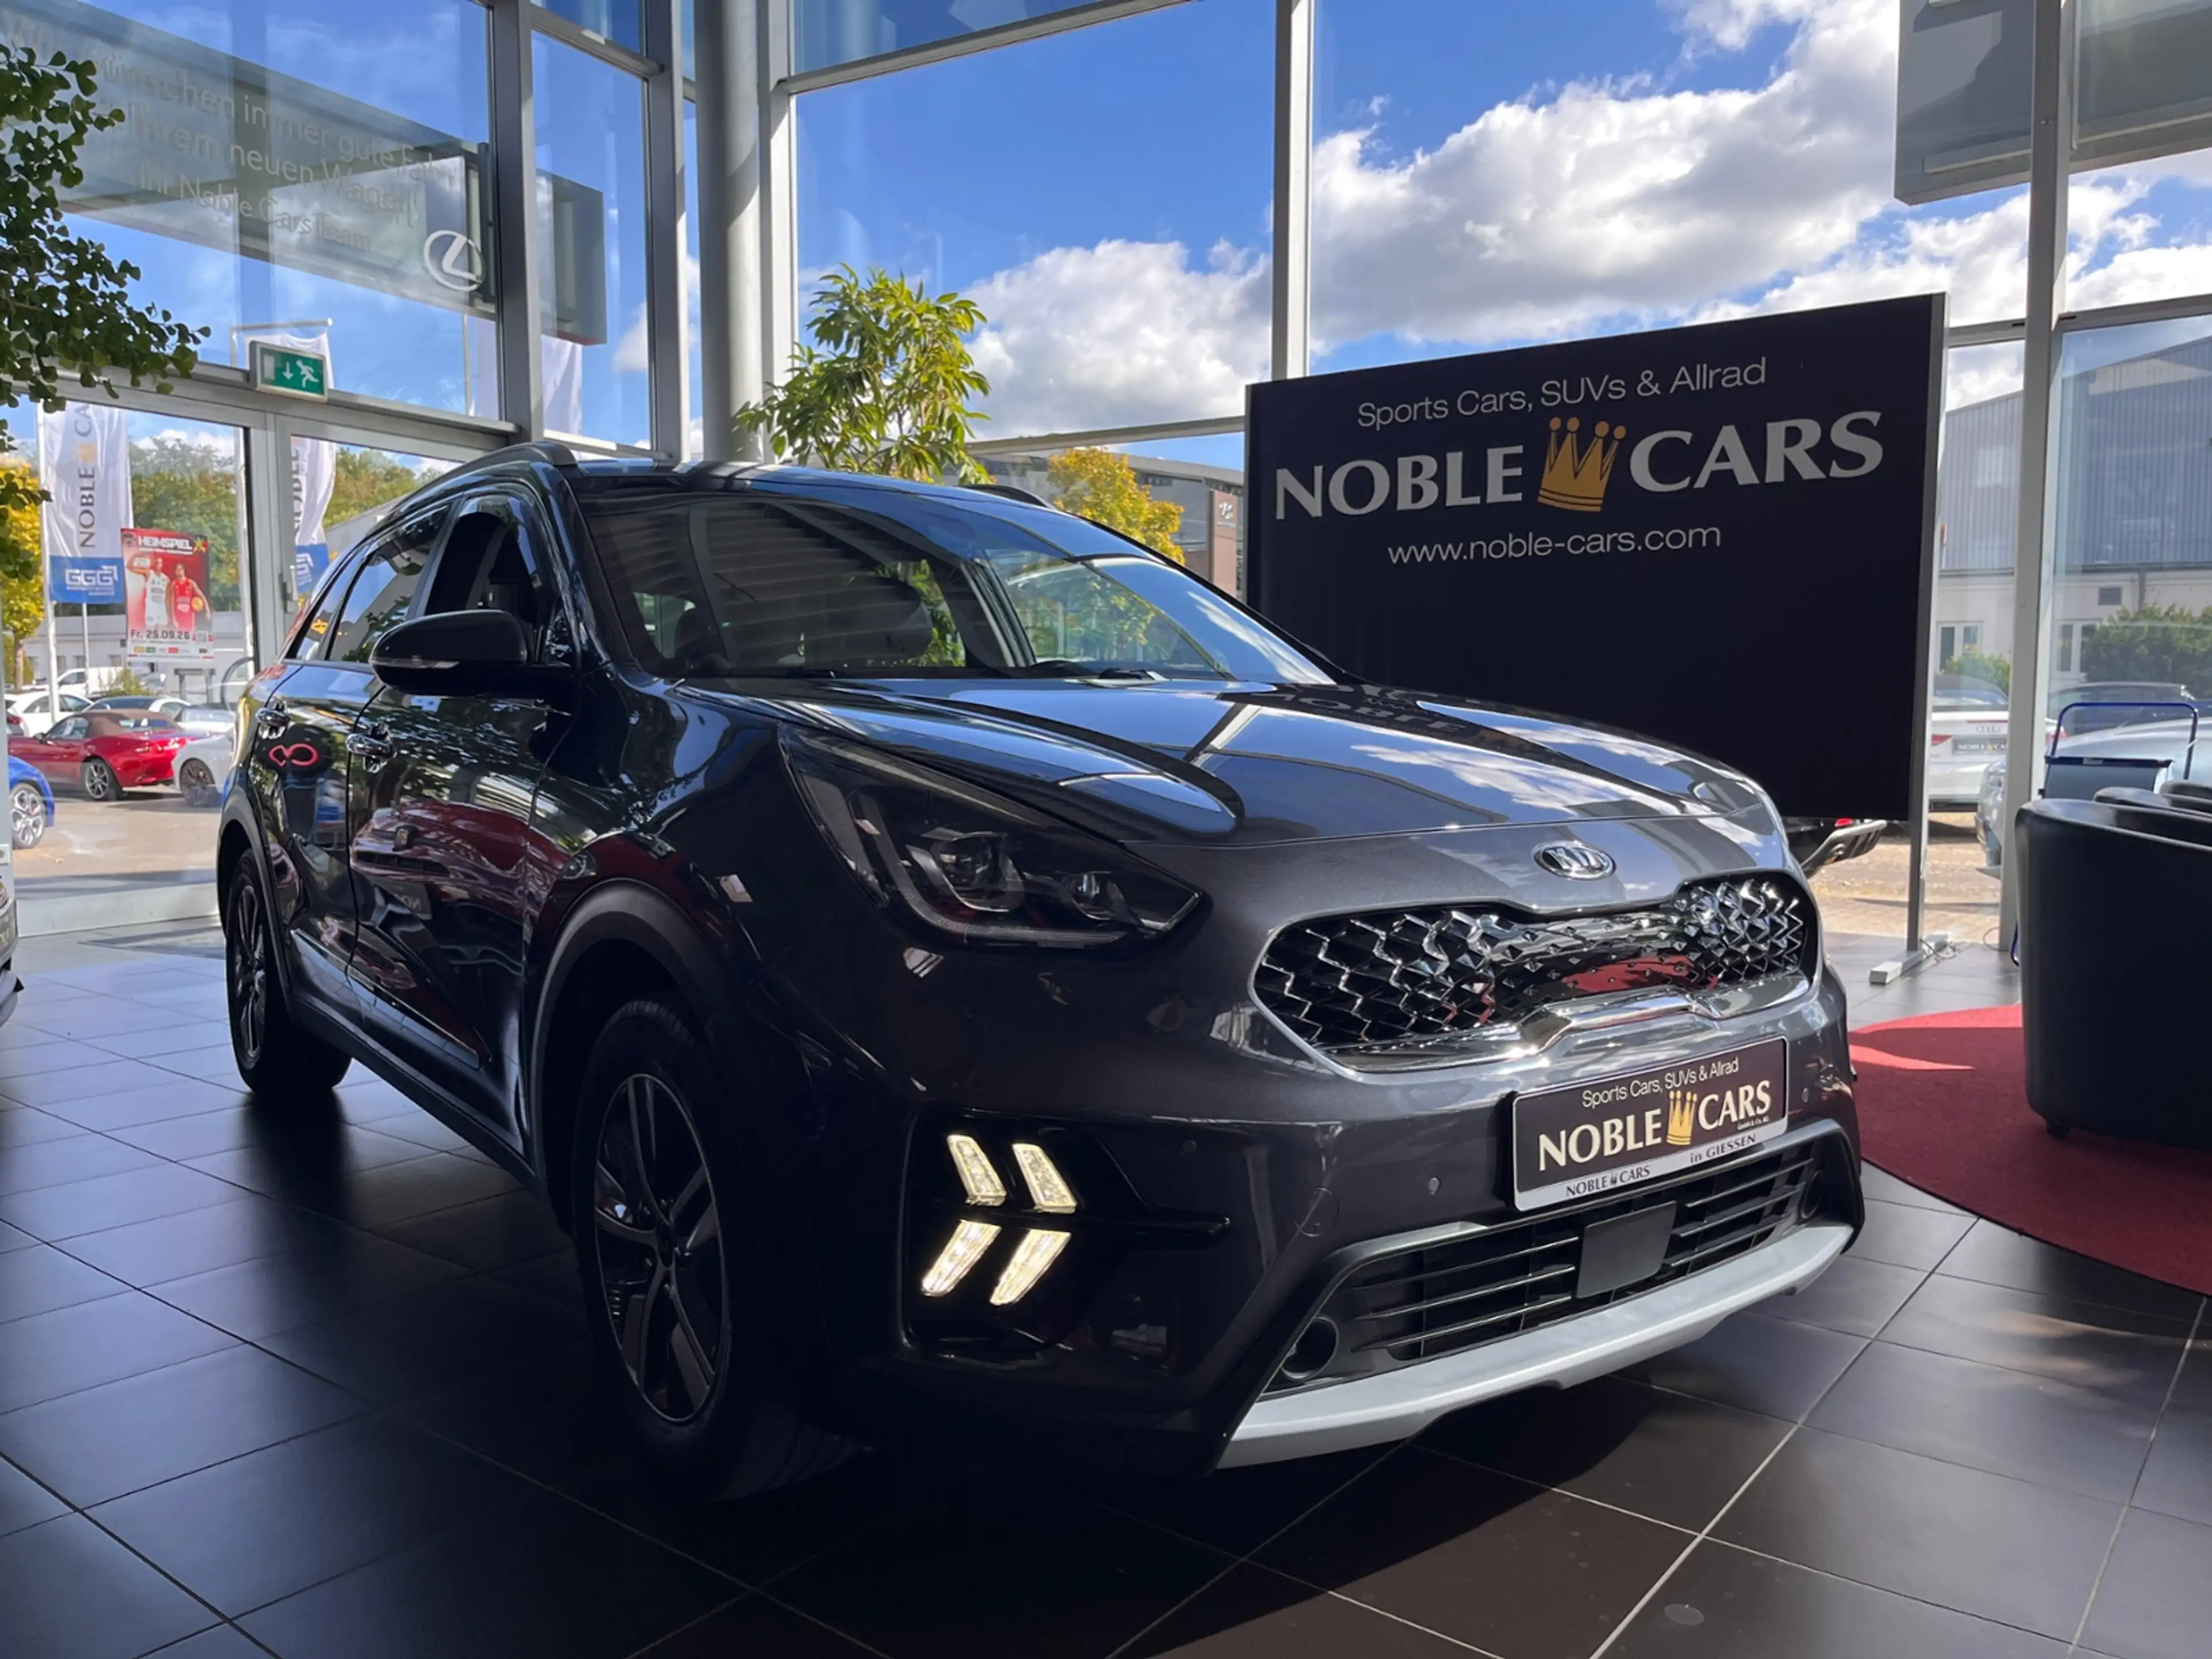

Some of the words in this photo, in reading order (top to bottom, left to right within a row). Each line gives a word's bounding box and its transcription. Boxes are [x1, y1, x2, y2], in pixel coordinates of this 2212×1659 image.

[230, 144, 314, 184] neuen
[1358, 396, 1448, 431] Sports
[1457, 389, 1533, 416] Cars,
[1541, 374, 1626, 406] SUVs
[1637, 370, 1661, 396] &
[1669, 357, 1766, 393] Allrad
[1275, 445, 1523, 520] NOBLE
[1630, 411, 1884, 493] CARS
[78, 467, 96, 548] NOBLE
[1387, 527, 1721, 563] www.noble-cars.com
[1582, 1086, 1627, 1109] Sports
[1630, 1078, 1662, 1097] Cars,
[1665, 1069, 1696, 1089] SUVs
[1699, 1069, 1708, 1081] &
[1709, 1058, 1738, 1078] Allrad
[1539, 1108, 1662, 1172] NOBLE
[1698, 1080, 1771, 1131] CARS
[1690, 1152, 1702, 1163] in
[1706, 1134, 1756, 1159] GIESSEN
[1566, 1176, 1608, 1198] NOBLE
[1619, 1165, 1650, 1183] CARS
